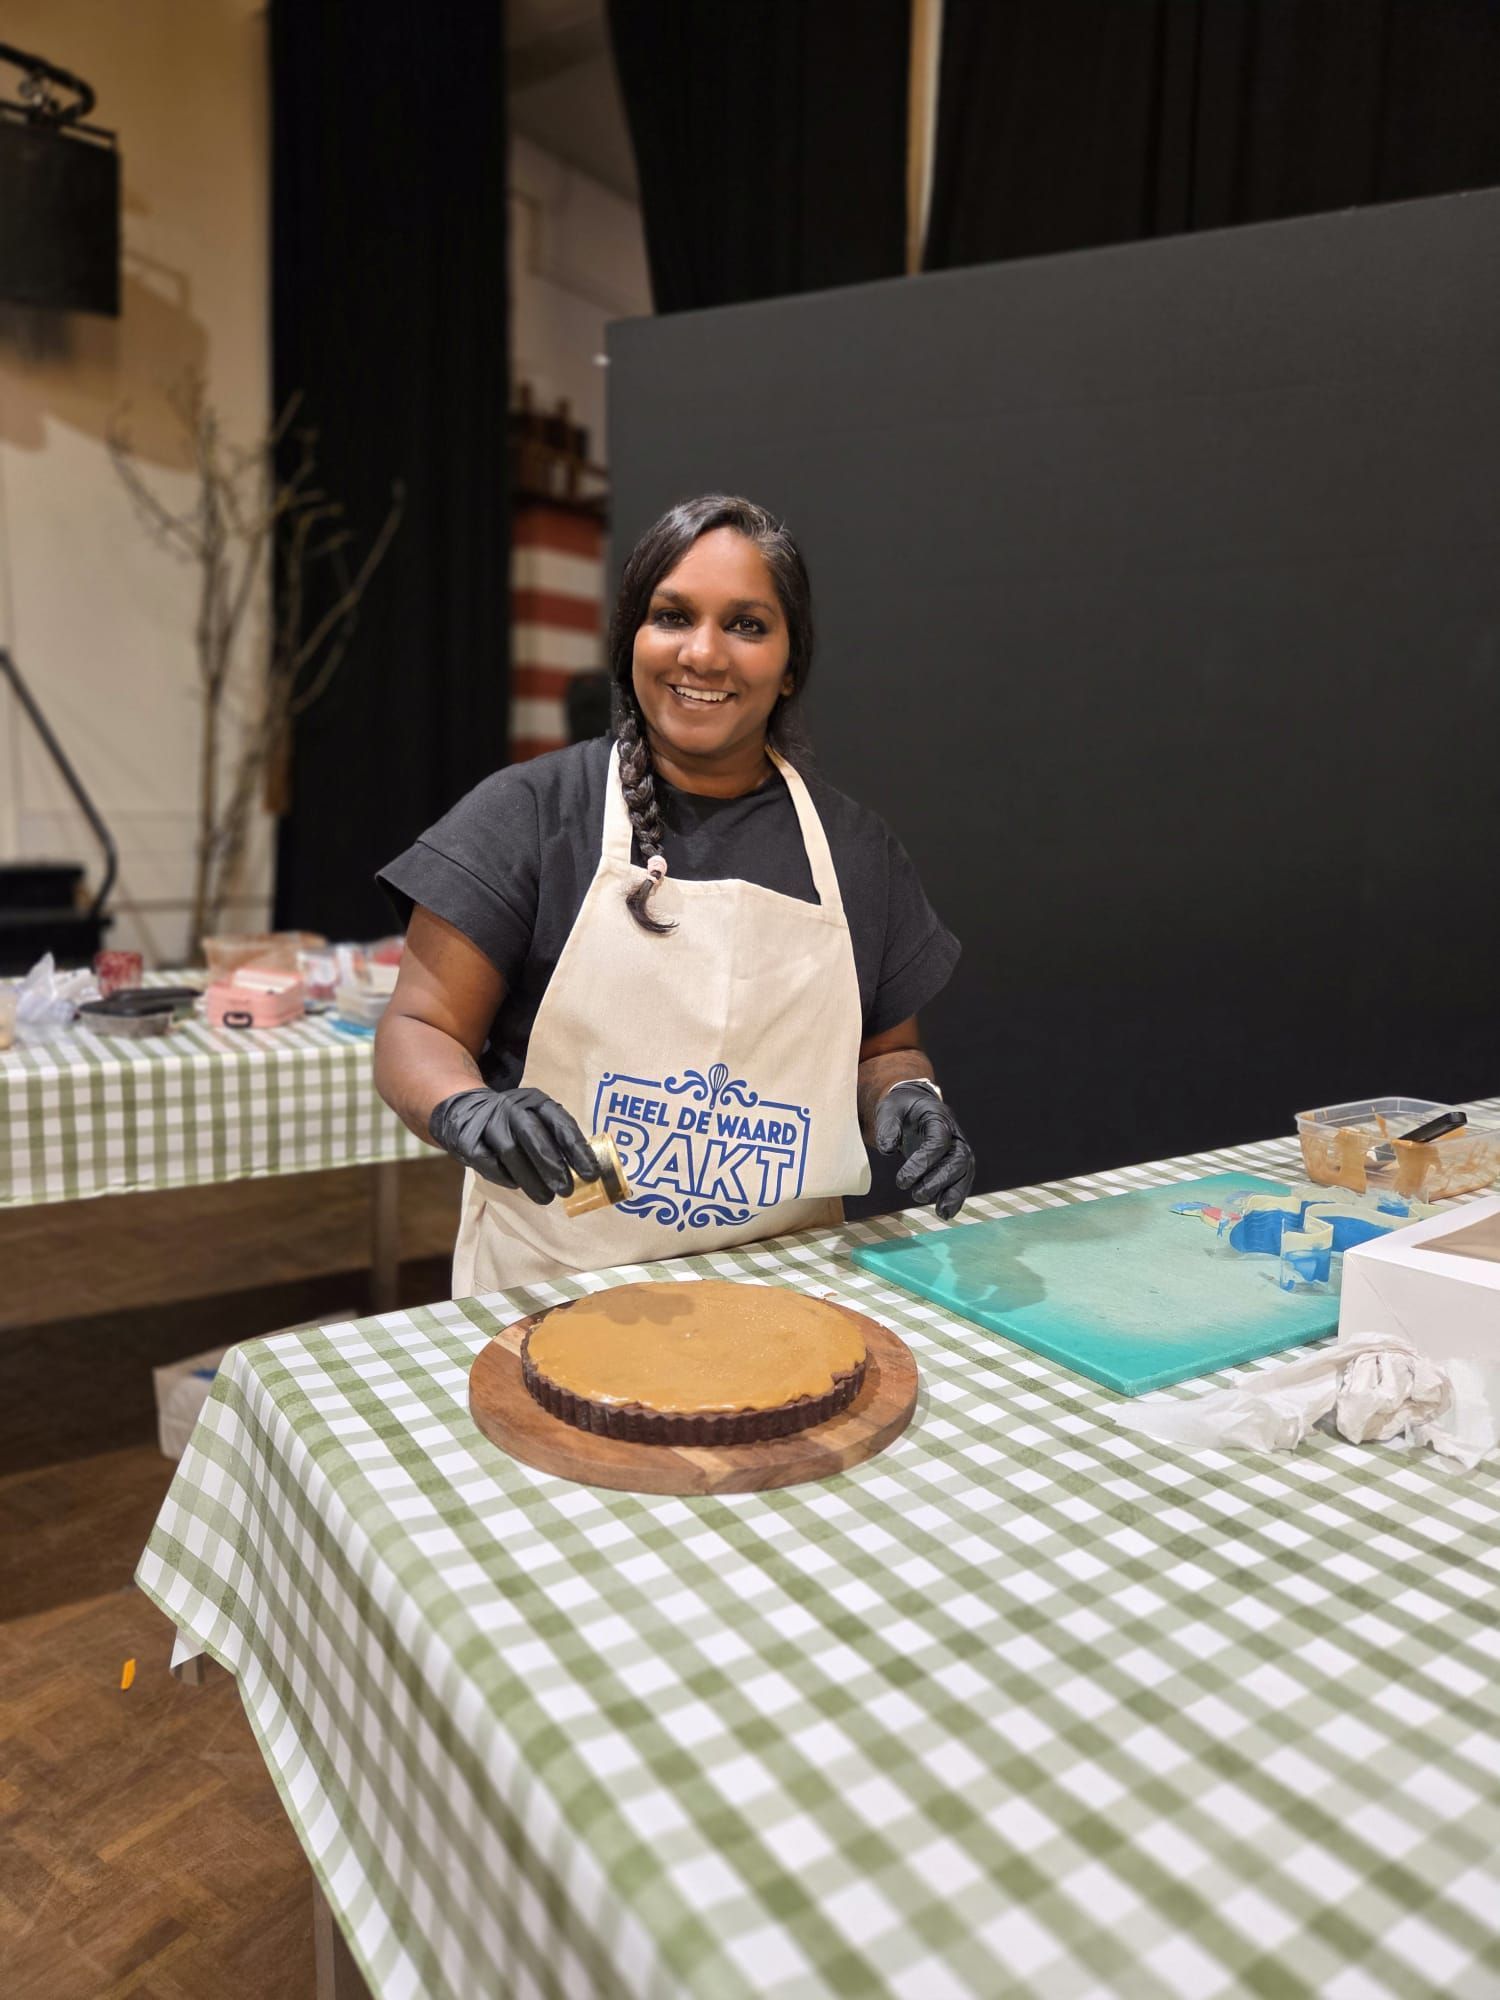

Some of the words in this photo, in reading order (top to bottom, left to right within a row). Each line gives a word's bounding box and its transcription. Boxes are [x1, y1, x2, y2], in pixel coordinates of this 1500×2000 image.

[608, 1092, 670, 1127] HEEL
[677, 1107, 712, 1135] DE
[717, 1113, 797, 1145] WAARD
[603, 1116, 796, 1208] BAKT
